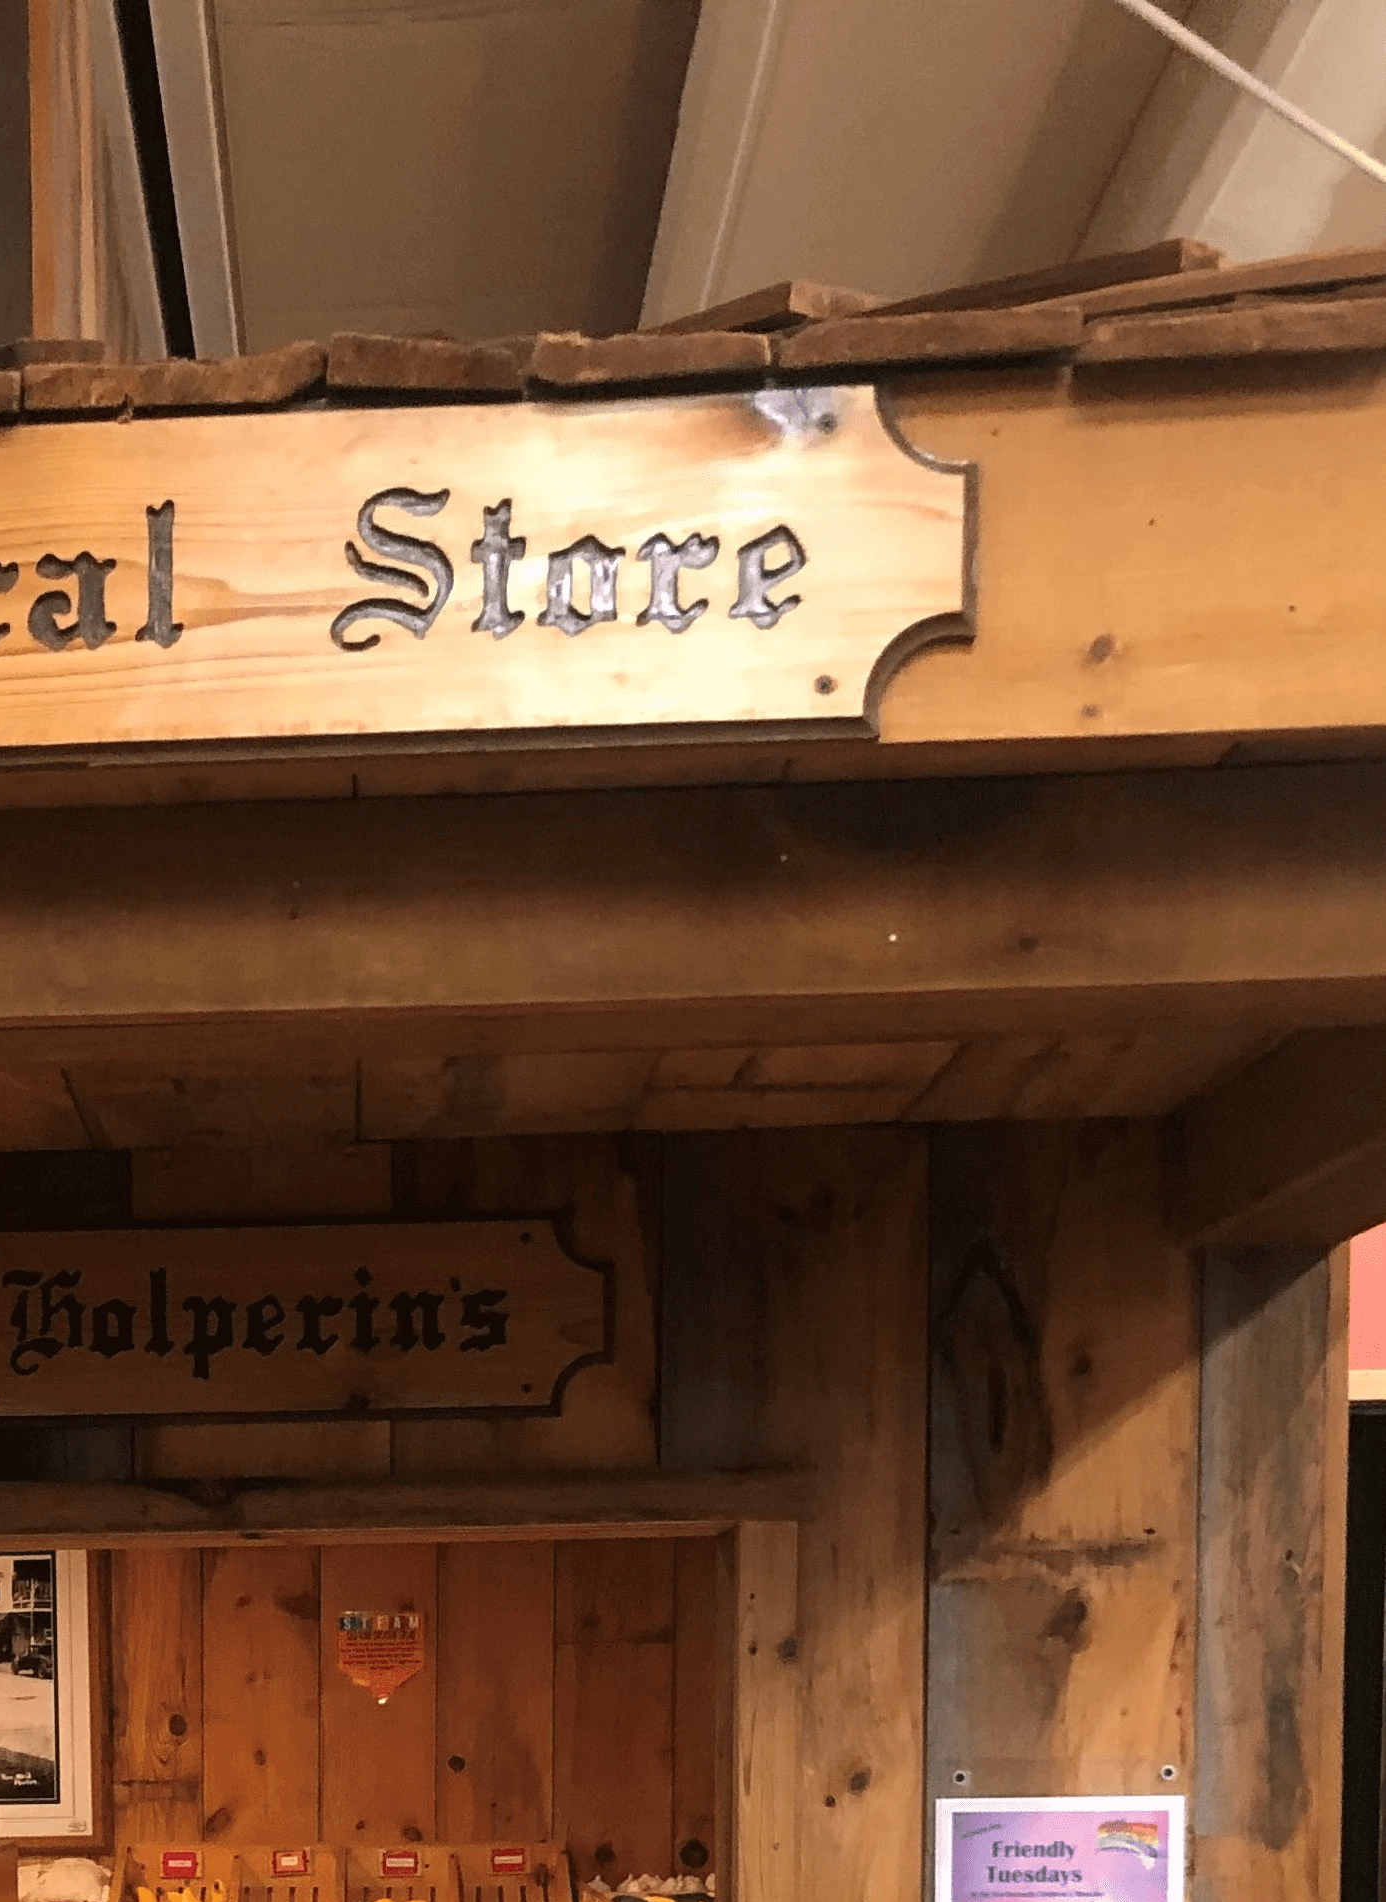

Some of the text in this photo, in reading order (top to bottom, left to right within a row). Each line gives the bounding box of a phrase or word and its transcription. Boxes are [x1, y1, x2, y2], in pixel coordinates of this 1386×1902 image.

[328, 486, 812, 654] Store
[1, 1266, 510, 1380] Holperin's
[986, 1865, 1083, 1886] Tuesdays
[991, 1840, 1075, 1861] Friendly
